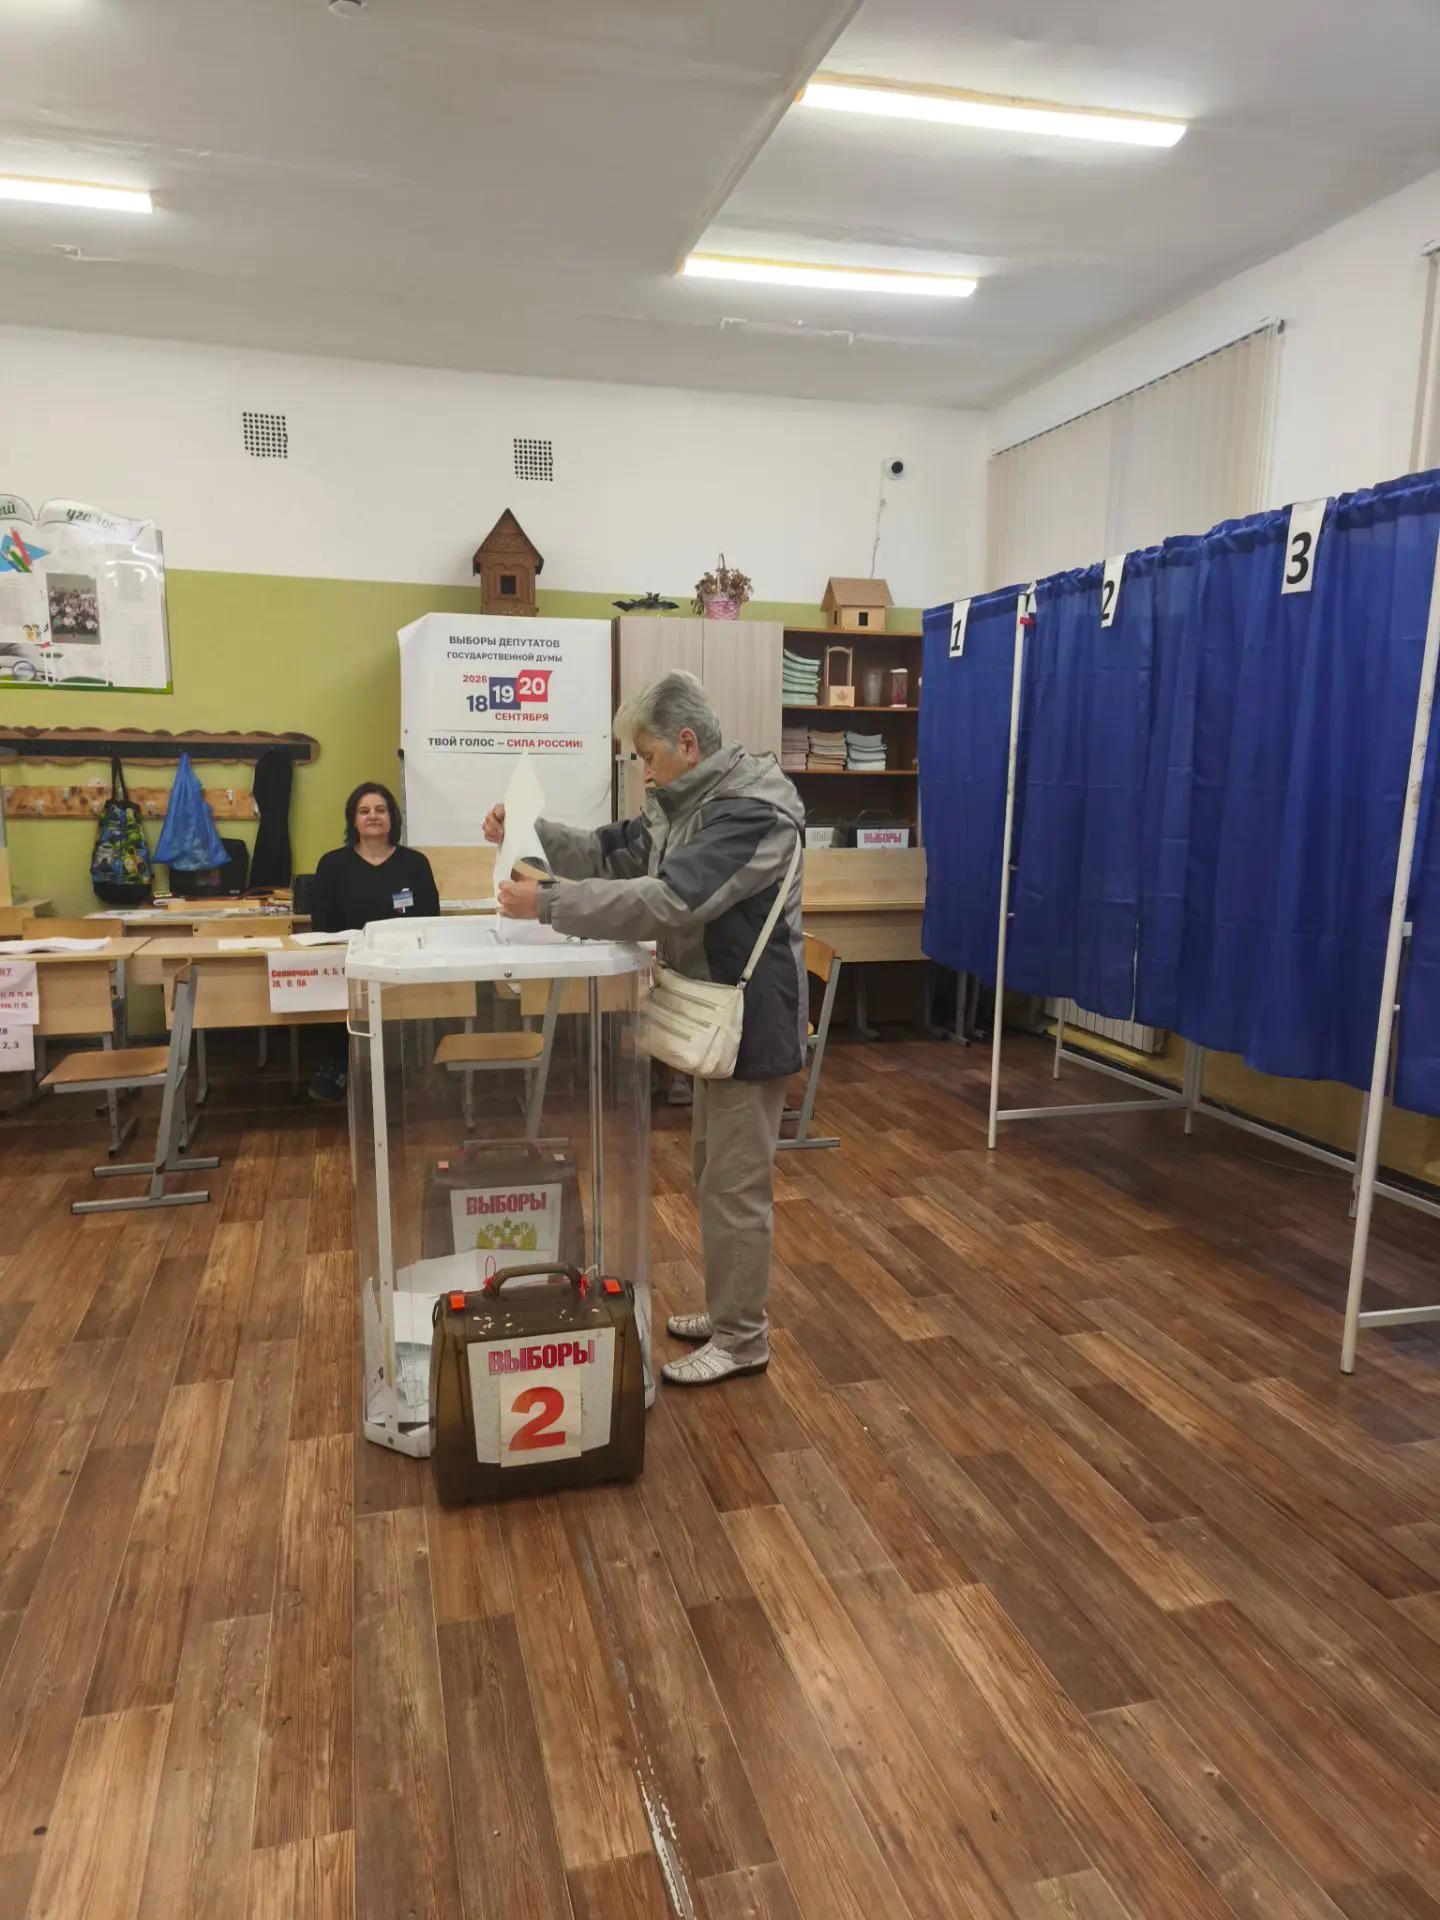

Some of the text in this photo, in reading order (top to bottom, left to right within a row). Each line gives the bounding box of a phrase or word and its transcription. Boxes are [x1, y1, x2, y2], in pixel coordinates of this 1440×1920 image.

[1286, 531, 1312, 585] 3
[1101, 580, 1115, 620] 2
[449, 635, 560, 648] ВЫБОРЫ ДЕПУТАТОВ
[951, 619, 962, 651] 1
[447, 650, 563, 663] ГОСУДАРСТВЕННОЙ ДУМЫ
[462, 674, 488, 684] 2026
[466, 676, 546, 713] 18 19 20
[494, 712, 549, 722] СЕНТЯБРЯ
[428, 735, 457, 747] ТВОЙ
[459, 738, 494, 747] ГОЛОС
[506, 738, 534, 748] СИЛА
[537, 739, 583, 749] РОССИИ!
[863, 832, 902, 844] ВЫБОРЫ
[466, 1191, 547, 1215] ВЫБОРЫ
[488, 1339, 595, 1375] ВЫБОРЫ
[508, 1385, 566, 1452] 2
